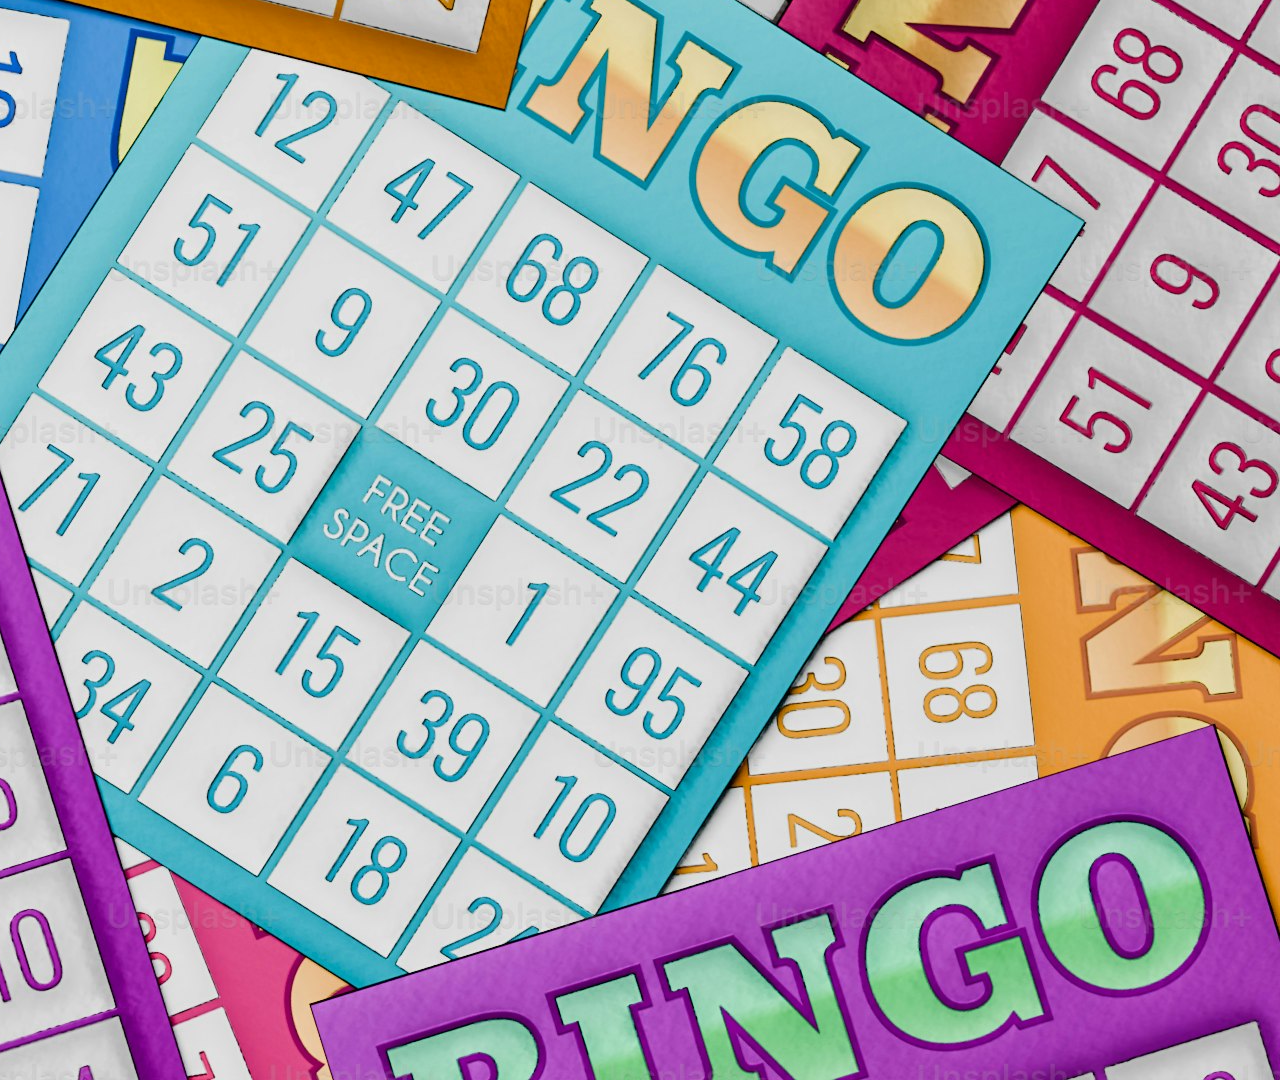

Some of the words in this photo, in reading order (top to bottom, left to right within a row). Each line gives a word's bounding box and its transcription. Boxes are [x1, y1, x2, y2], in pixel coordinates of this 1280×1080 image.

[1091, 28, 1183, 120] 68
[255, 74, 337, 163] 12
[174, 194, 260, 287] 51
[384, 159, 473, 239] 47
[639, 312, 727, 406] 76
[212, 401, 314, 494] 25
[426, 358, 520, 450] 30
[1059, 367, 1151, 453] 51
[19, 444, 100, 536] 71
[362, 474, 450, 547] FREE
[1192, 442, 1278, 530] 43
[322, 508, 438, 596] SPACE
[689, 527, 778, 616] 44
[276, 612, 360, 698] 15
[506, 583, 549, 646] 1
[919, 641, 997, 723] 68
[326, 819, 407, 905] 18
[534, 776, 616, 862] 10
